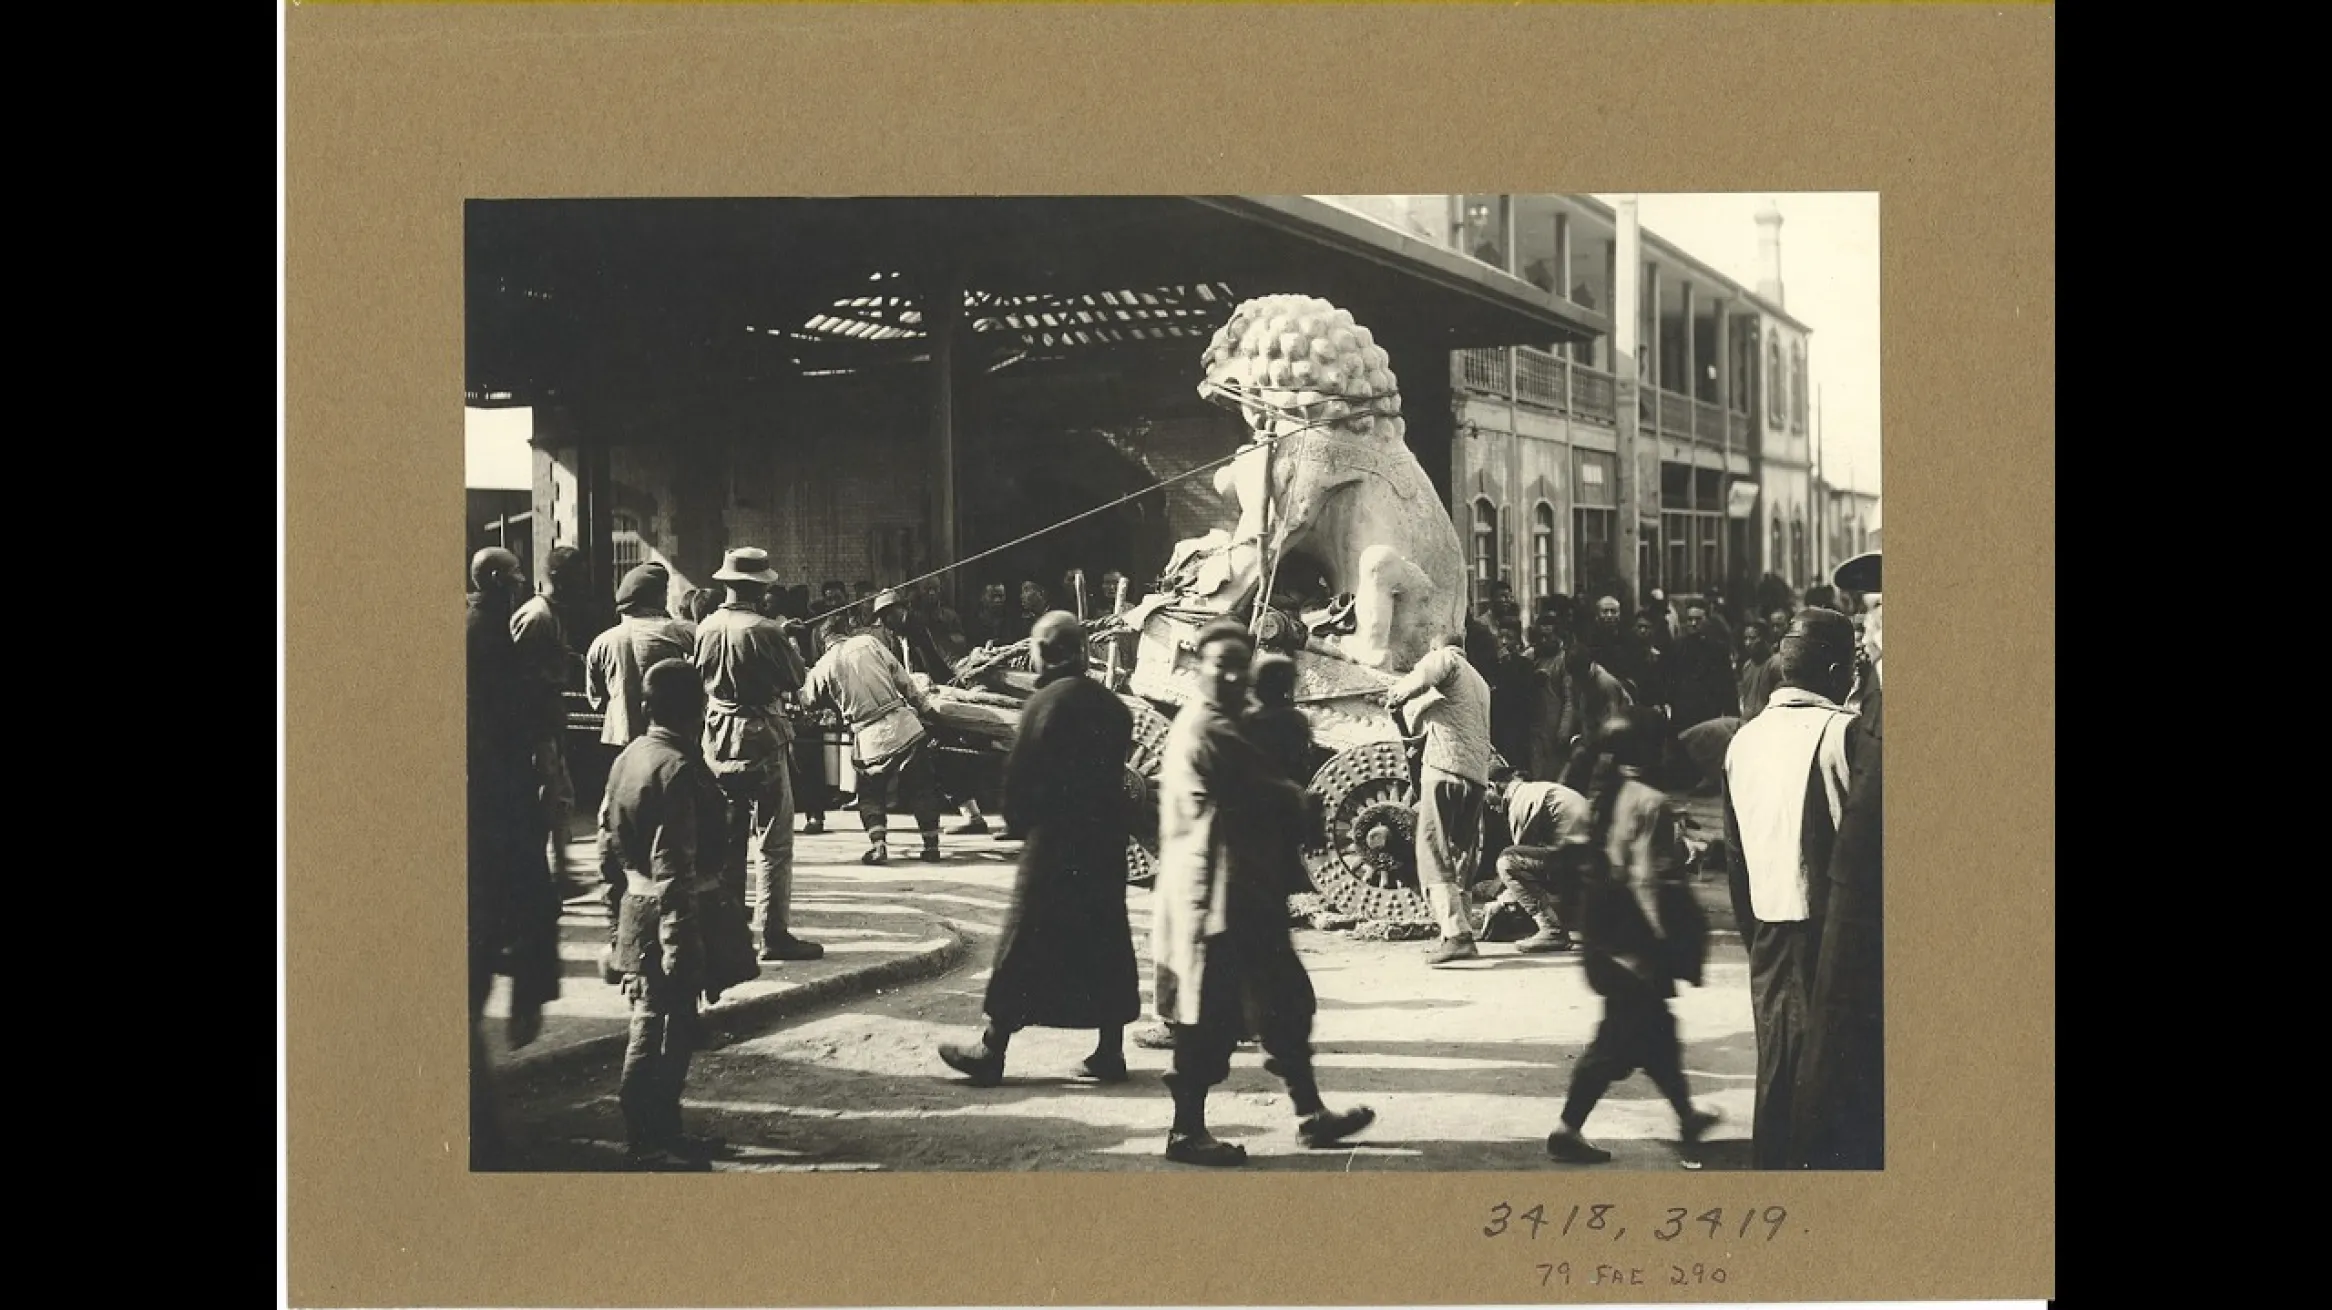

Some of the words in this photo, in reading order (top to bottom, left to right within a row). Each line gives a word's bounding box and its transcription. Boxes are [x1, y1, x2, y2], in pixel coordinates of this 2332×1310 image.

[1483, 1201, 1626, 1241] 3418,
[1535, 1261, 1571, 1287] 79
[1670, 1262, 1727, 1286] 290
